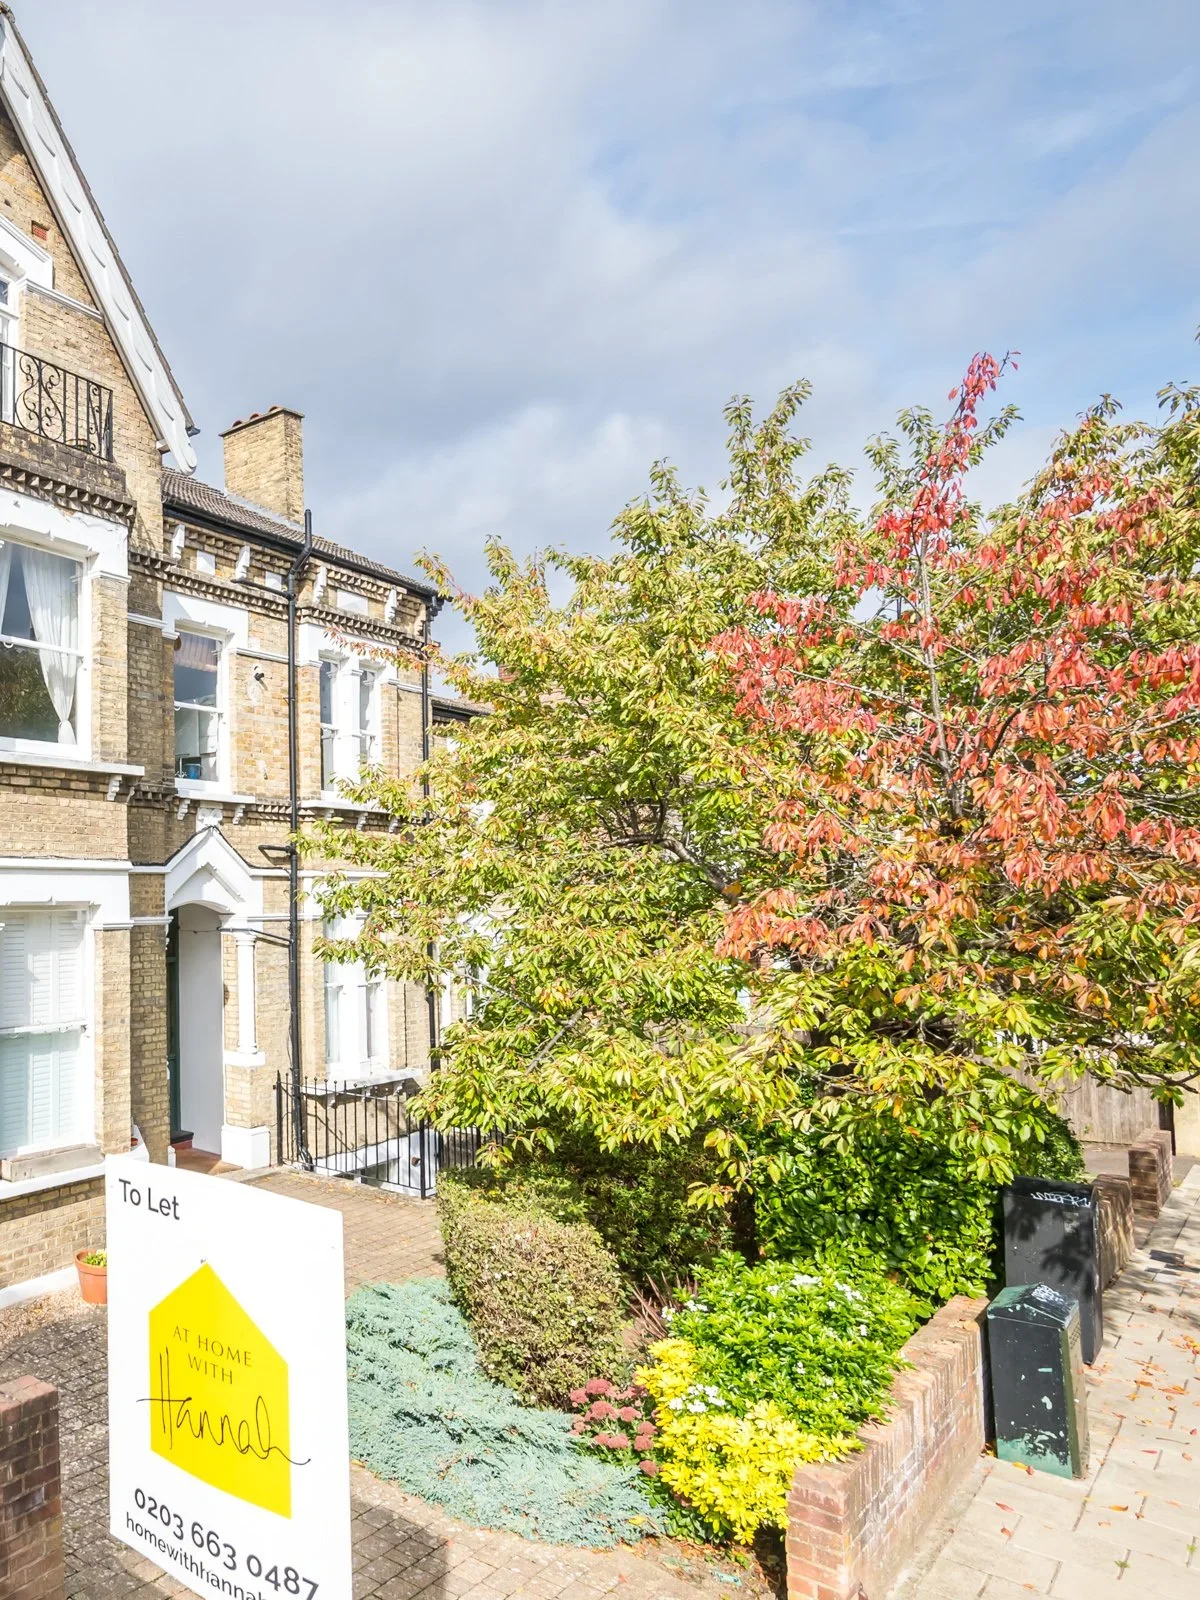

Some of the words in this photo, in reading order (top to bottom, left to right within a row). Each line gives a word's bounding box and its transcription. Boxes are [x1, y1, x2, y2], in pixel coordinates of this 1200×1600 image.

[118, 1178, 141, 1206] To
[147, 1187, 180, 1220] Let
[173, 1325, 190, 1343] AT
[197, 1334, 253, 1368] HOME
[187, 1353, 234, 1385] WITH
[136, 1346, 311, 1466] Hannah
[134, 1487, 184, 1541] 0203
[191, 1521, 237, 1571] 663
[246, 1554, 319, 1600] 0487
